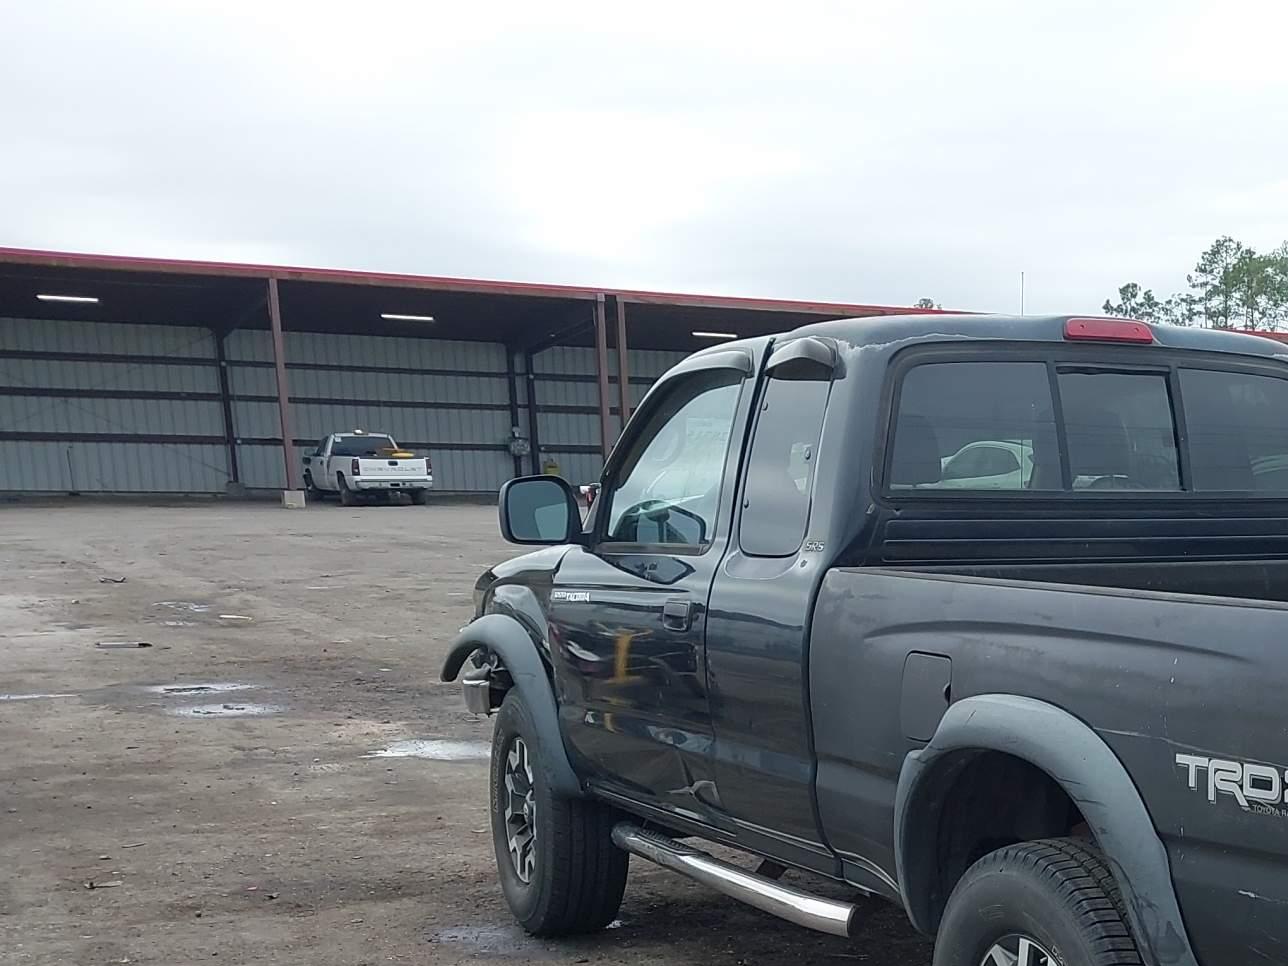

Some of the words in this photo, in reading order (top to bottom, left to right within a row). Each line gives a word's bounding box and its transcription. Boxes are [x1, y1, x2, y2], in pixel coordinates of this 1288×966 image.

[806, 541, 825, 552] SR5
[1175, 753, 1282, 808] TRD
[1252, 804, 1280, 817] TOYOTA
